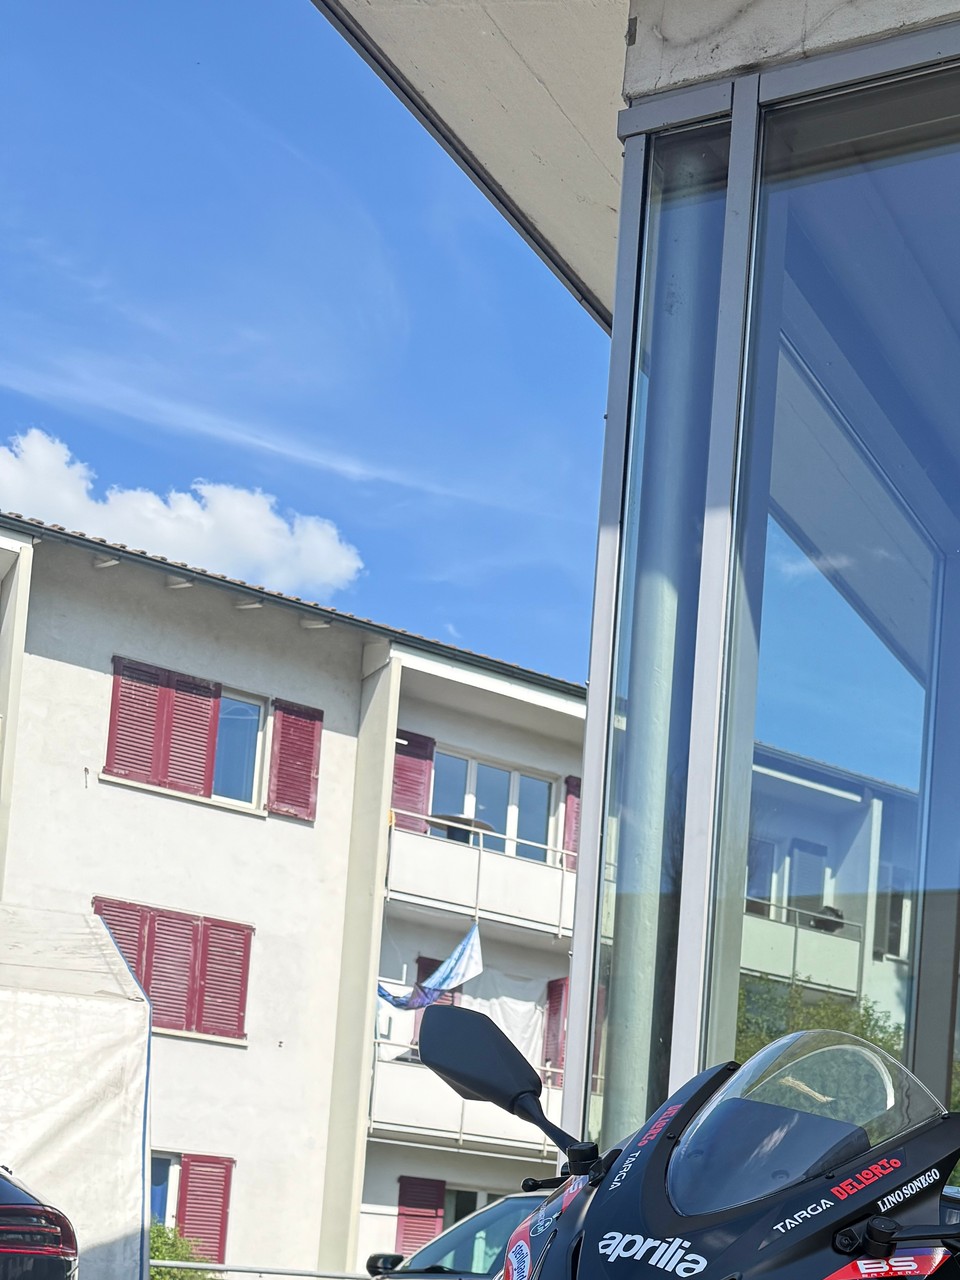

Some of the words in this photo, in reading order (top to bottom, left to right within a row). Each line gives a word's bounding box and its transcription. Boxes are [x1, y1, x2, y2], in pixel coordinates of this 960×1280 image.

[609, 1150, 641, 1191] TARGA
[877, 1191, 904, 1213] LINO
[902, 1168, 940, 1198] SONEGO
[773, 1199, 834, 1233] TARGA
[598, 1231, 708, 1278] aprilia
[856, 1256, 919, 1274] BS
